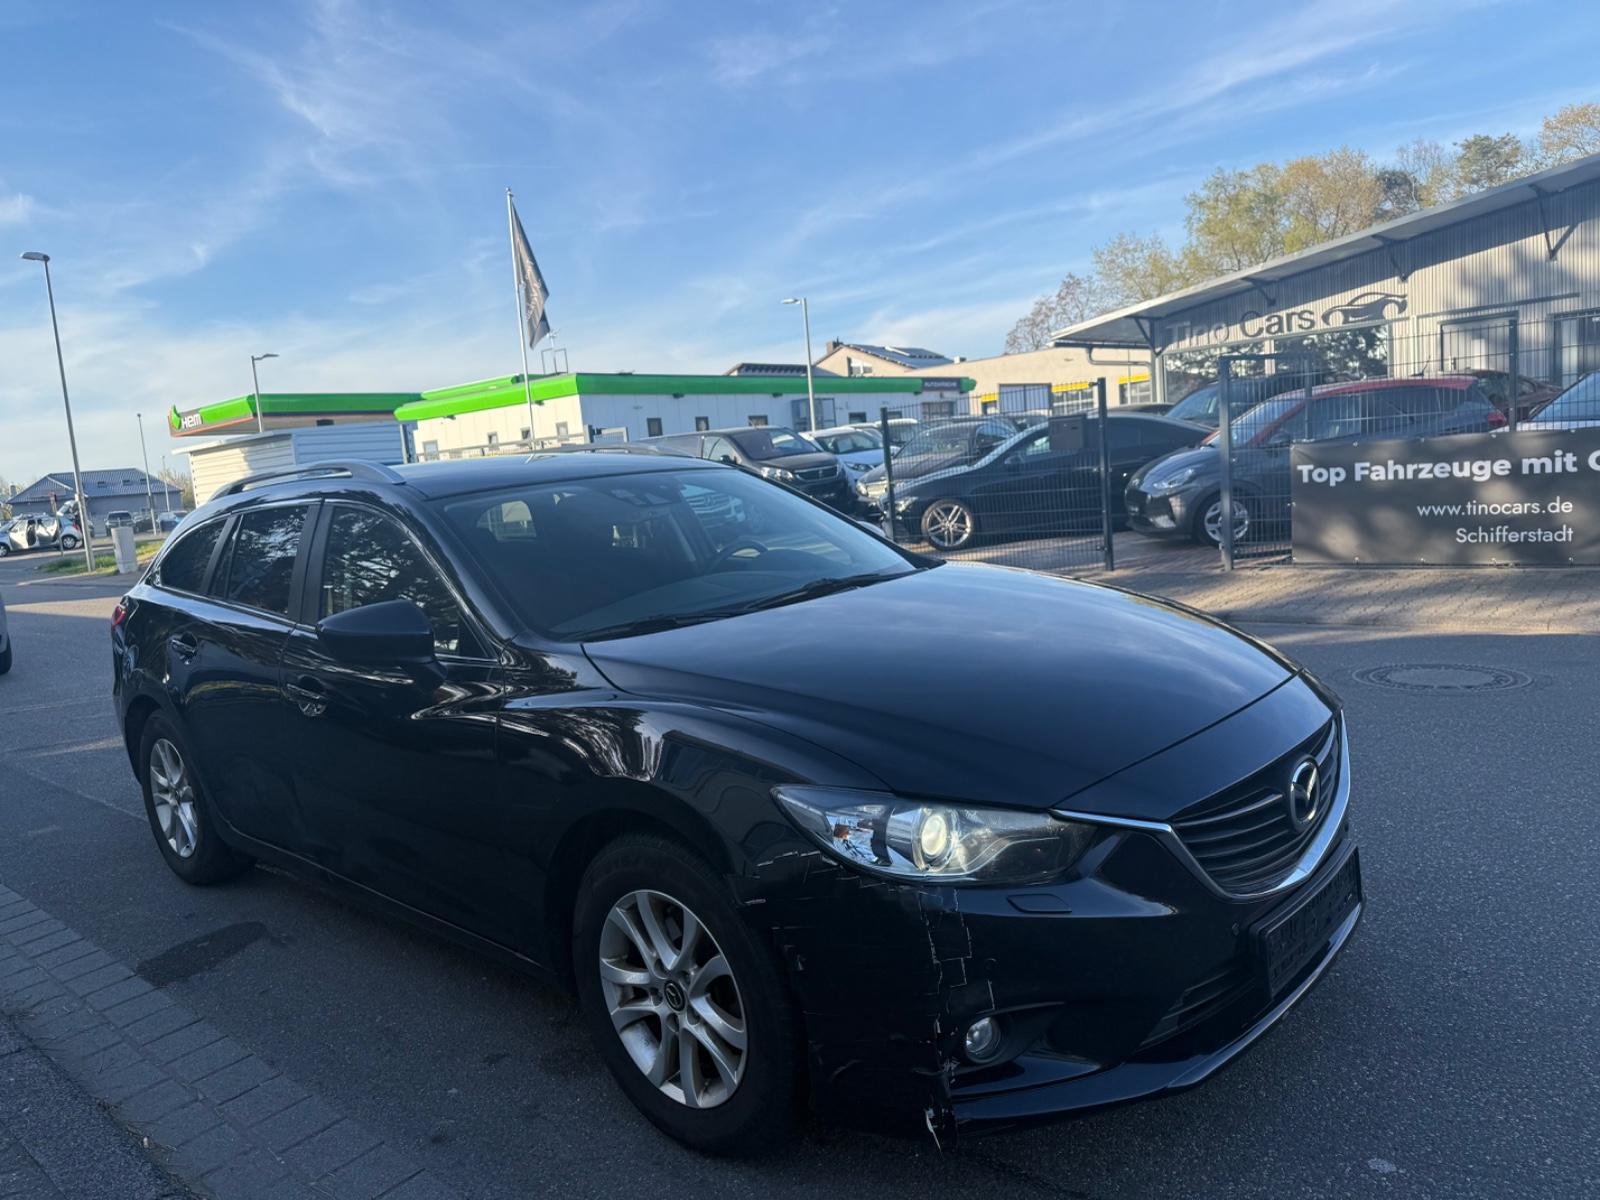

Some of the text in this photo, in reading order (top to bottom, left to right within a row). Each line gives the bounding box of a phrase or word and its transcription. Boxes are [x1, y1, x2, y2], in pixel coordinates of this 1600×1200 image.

[1240, 311, 1315, 338] Cars
[1297, 465, 1347, 487] Top
[1354, 459, 1511, 482] Fahrzeuge
[1522, 450, 1578, 475] mit
[1416, 496, 1573, 517] www.tinocars.de
[1455, 525, 1574, 543] Schifferstadt
